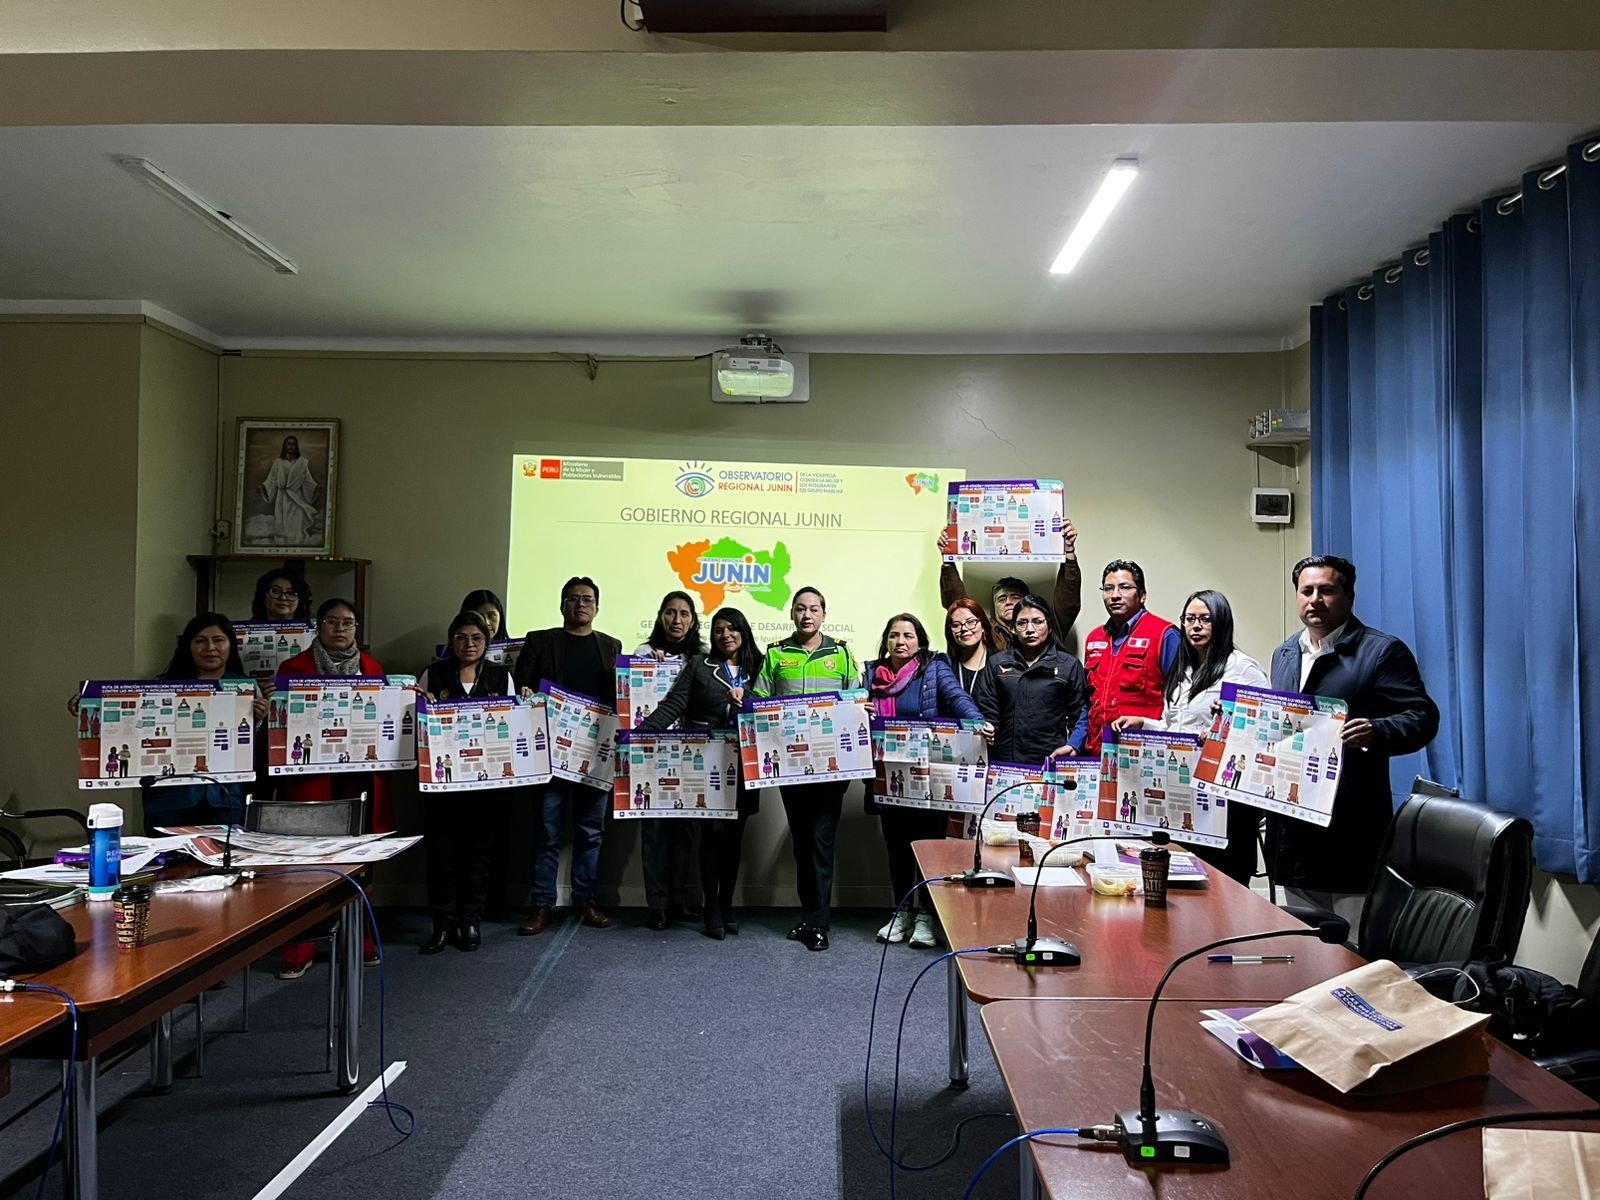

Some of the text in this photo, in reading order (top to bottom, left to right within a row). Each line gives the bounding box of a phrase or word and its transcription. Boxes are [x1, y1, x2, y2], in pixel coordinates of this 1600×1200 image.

[542, 465, 559, 473] PERÚ
[719, 470, 793, 482] OBSERVATORIO
[718, 482, 764, 491] REGIONAL
[620, 507, 842, 527] GOBIERNO REGIONAL JUNIN
[758, 622, 795, 631] DESARR
[822, 624, 855, 633] SOCIAL
